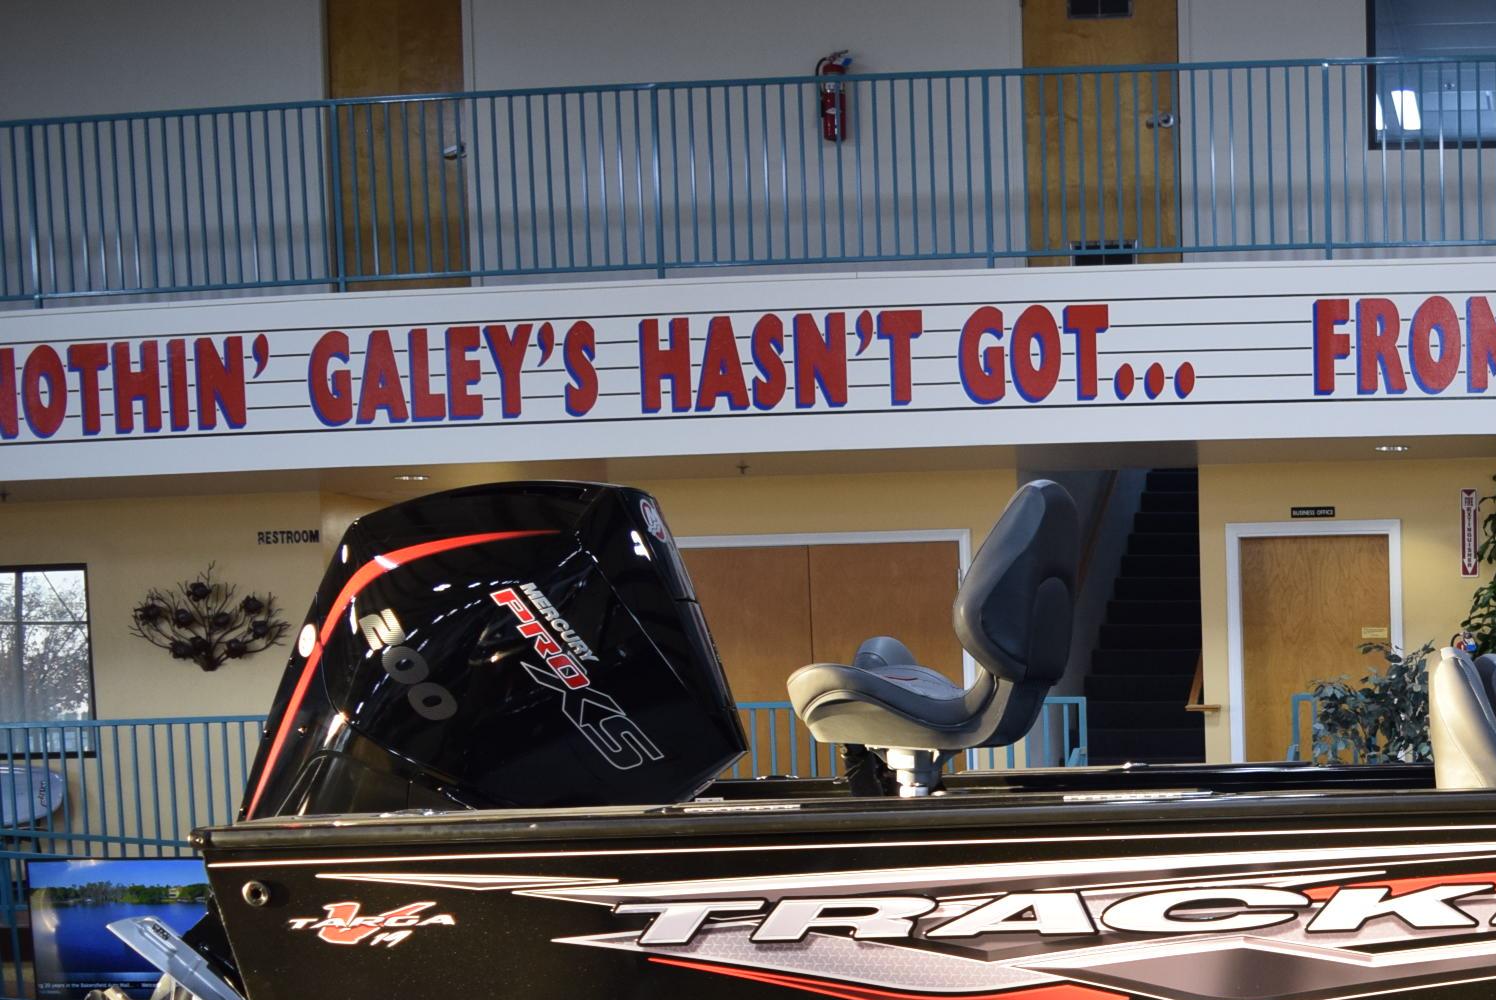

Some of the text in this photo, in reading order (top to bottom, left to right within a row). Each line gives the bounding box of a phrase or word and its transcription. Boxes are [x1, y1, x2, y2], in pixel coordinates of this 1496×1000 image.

[308, 319, 599, 427] GALEY'S
[638, 309, 923, 414] HASN'T
[957, 304, 1196, 405] GOT...
[257, 529, 319, 545] RESTROOM
[358, 608, 459, 721] 200
[519, 582, 600, 663] MERCURY
[490, 587, 665, 771] PRO XS
[289, 914, 456, 930] TARGA
